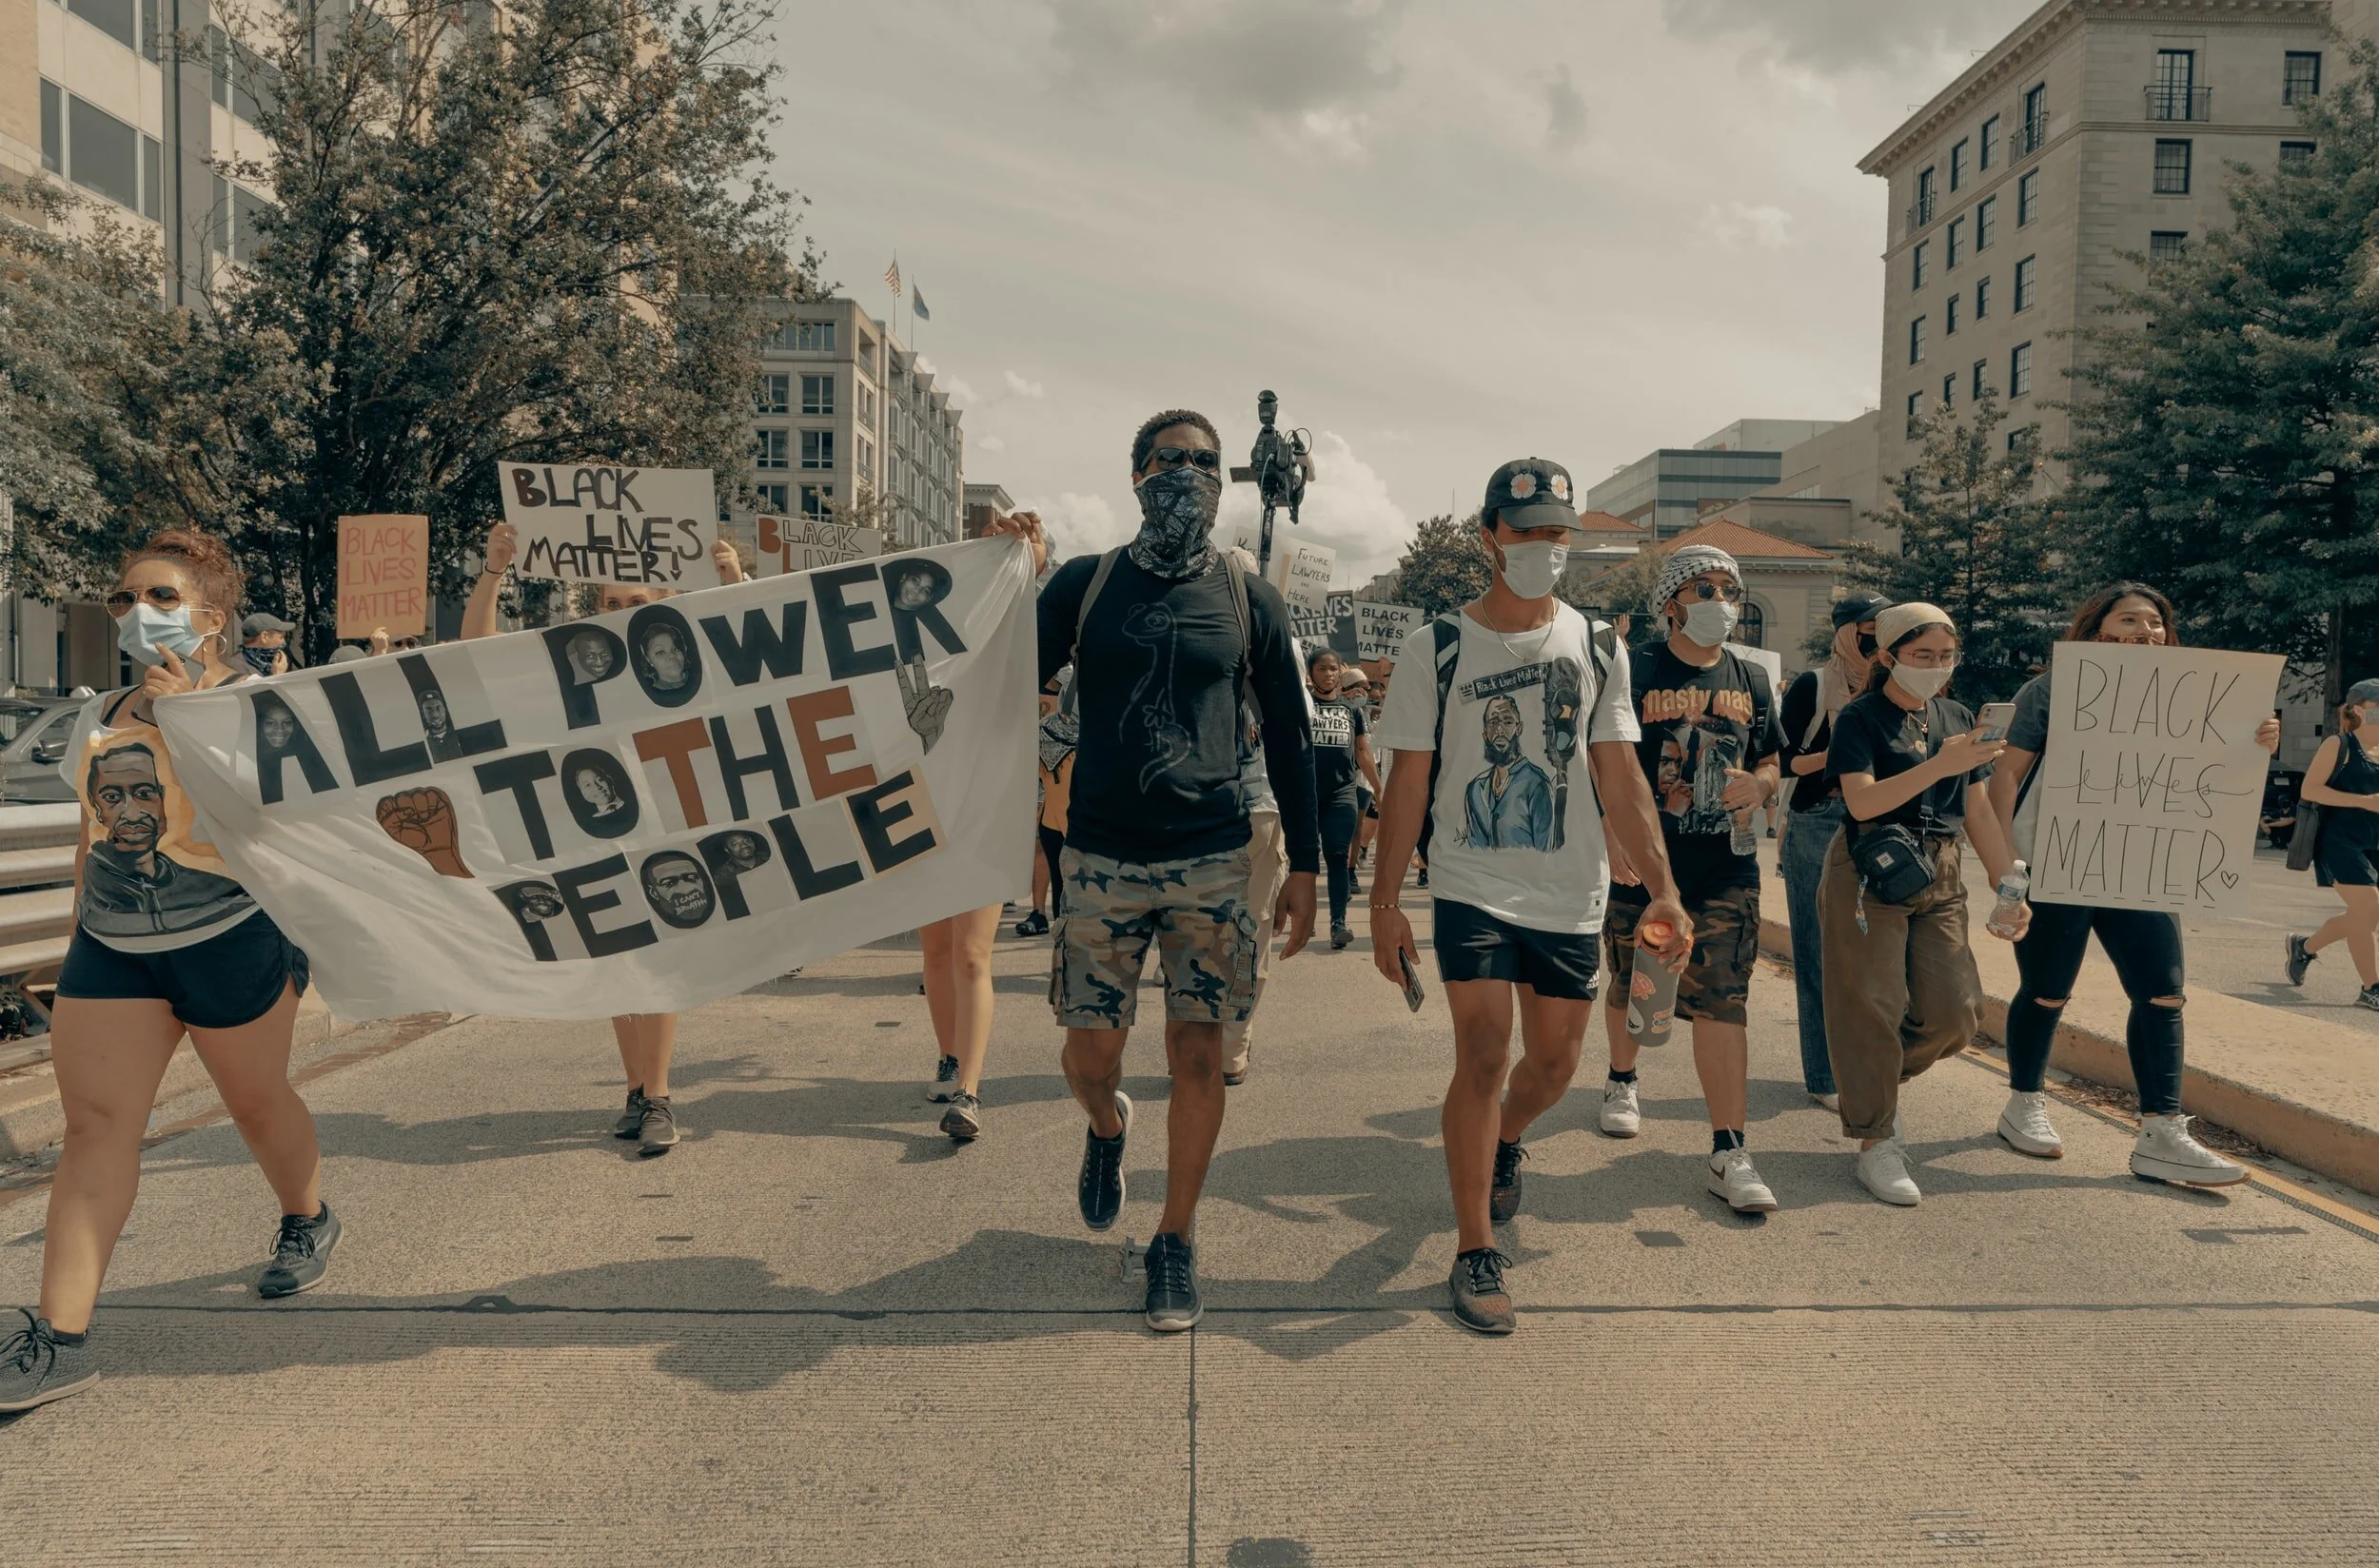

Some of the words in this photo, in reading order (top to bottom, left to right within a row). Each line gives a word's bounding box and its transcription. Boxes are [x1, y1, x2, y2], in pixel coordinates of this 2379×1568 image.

[512, 467, 644, 513] BLACK
[345, 527, 417, 556] BLACK
[586, 514, 703, 560] LIVES
[758, 518, 864, 554] BLACK
[345, 558, 416, 586] LIVES
[522, 536, 682, 582] MATTER!
[783, 542, 864, 574] LIV
[1291, 564, 1330, 582] LAWYERS
[341, 587, 423, 622] MATTER
[1288, 587, 1309, 604] HERE
[1291, 617, 1338, 637] ATTER
[1362, 608, 1409, 622] BLACK
[1363, 624, 1404, 638] LIVES
[1358, 641, 1401, 657] ATTE
[250, 654, 507, 805] ALL
[541, 558, 967, 730] POWER
[1476, 677, 1498, 694] Black
[1499, 676, 1517, 688] Lives
[1313, 706, 1348, 718] LACK
[1643, 685, 1712, 721] nasty
[1714, 691, 1753, 723] nas
[2074, 658, 2240, 745] BLACK
[1312, 718, 1348, 730] AWYERS
[473, 747, 639, 860] TO
[632, 685, 877, 829] THE
[2076, 751, 2227, 818] LIVES
[490, 770, 936, 961] PEOPLE
[2040, 815, 2215, 904] MATTER
